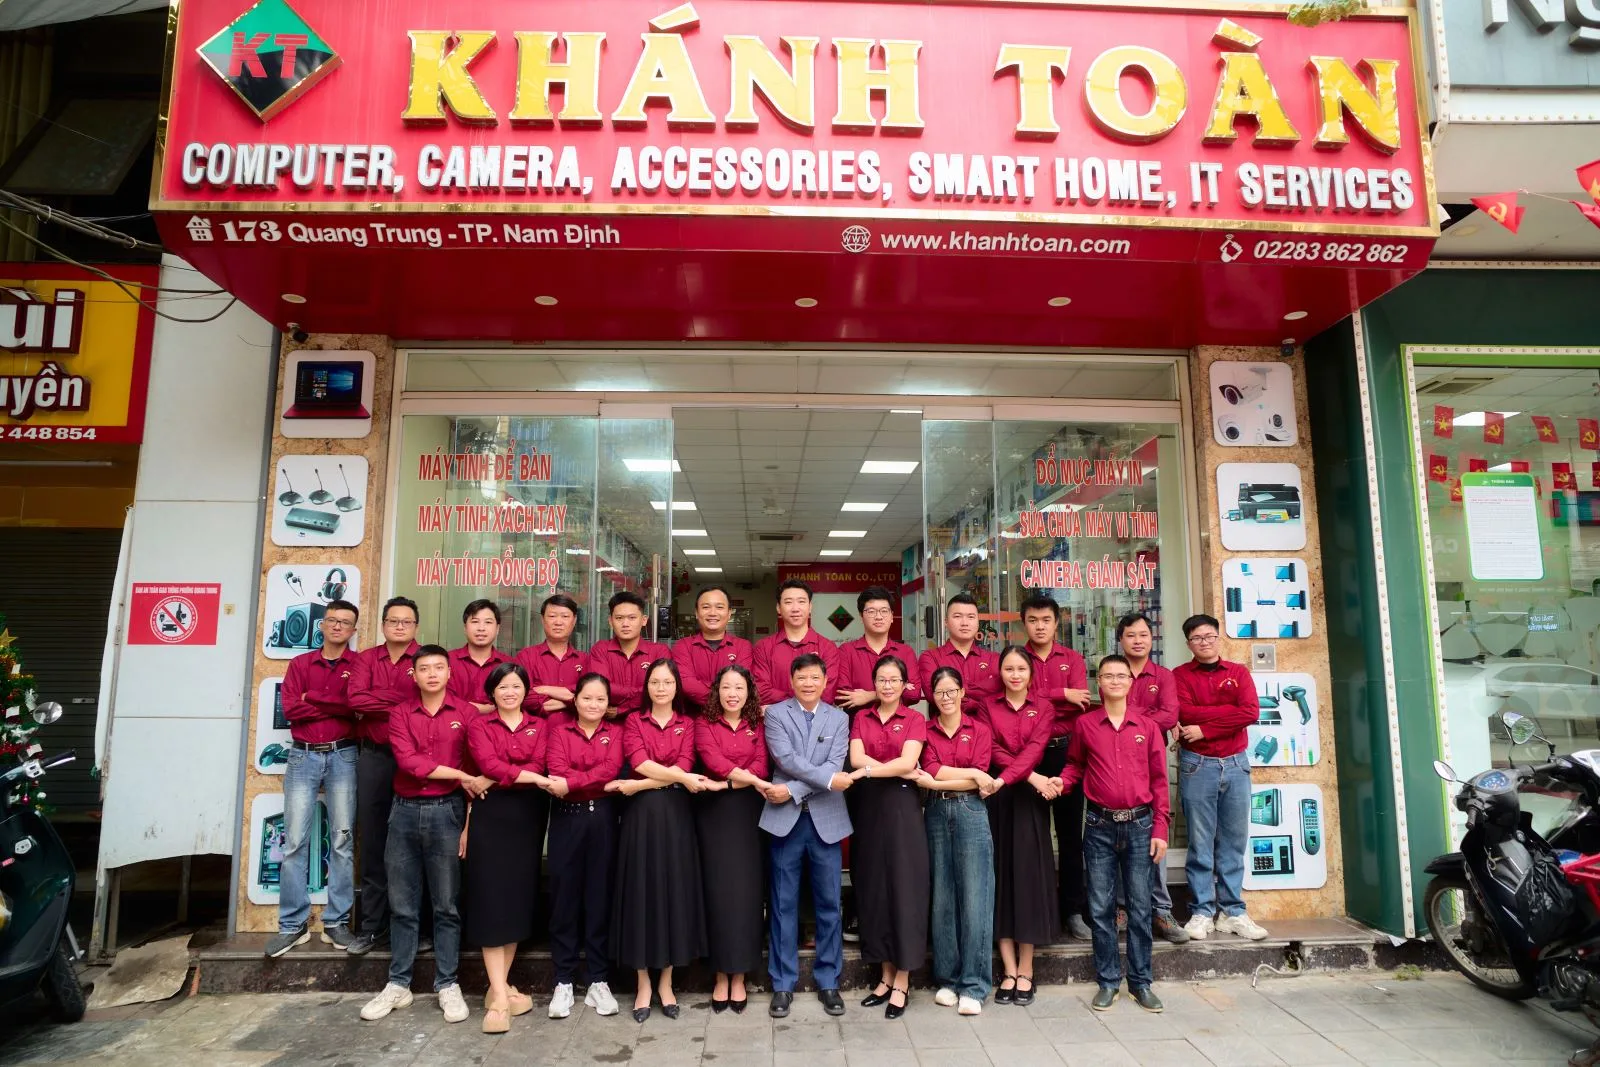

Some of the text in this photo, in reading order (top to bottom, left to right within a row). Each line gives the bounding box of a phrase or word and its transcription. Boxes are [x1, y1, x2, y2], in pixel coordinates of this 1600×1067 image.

[228, 31, 308, 79] KT
[401, 2, 1401, 155] KHÁNH TOÀN
[182, 142, 1415, 211] COMPUTER, CAMERA, ACCESSORIES, SMART HOME, IT SERVICES
[219, 220, 282, 243] 173
[288, 225, 369, 248] Quang
[370, 223, 442, 247] Trung
[504, 224, 557, 244] Nam
[565, 224, 620, 249] Định
[881, 230, 1131, 256] www.khanhtoan.com
[1254, 239, 1409, 264] 02283 862 862
[8, 427, 52, 440] 448
[55, 427, 97, 440] 854
[418, 446, 452, 481] MÁY
[455, 446, 489, 481] TÍNH
[520, 447, 552, 481] BÀN
[1036, 443, 1144, 493] ĐỔ MỰC MÁY IN
[418, 497, 567, 534] MÁY TÍNH XÁCH TAY
[1019, 500, 1159, 539] SỬA CHỮA MÁY VI TÍNH
[417, 545, 560, 595] MÁY TÍNH ĐỒNG BỘ
[1020, 554, 1157, 590] CAMERA GIÁM SÁT
